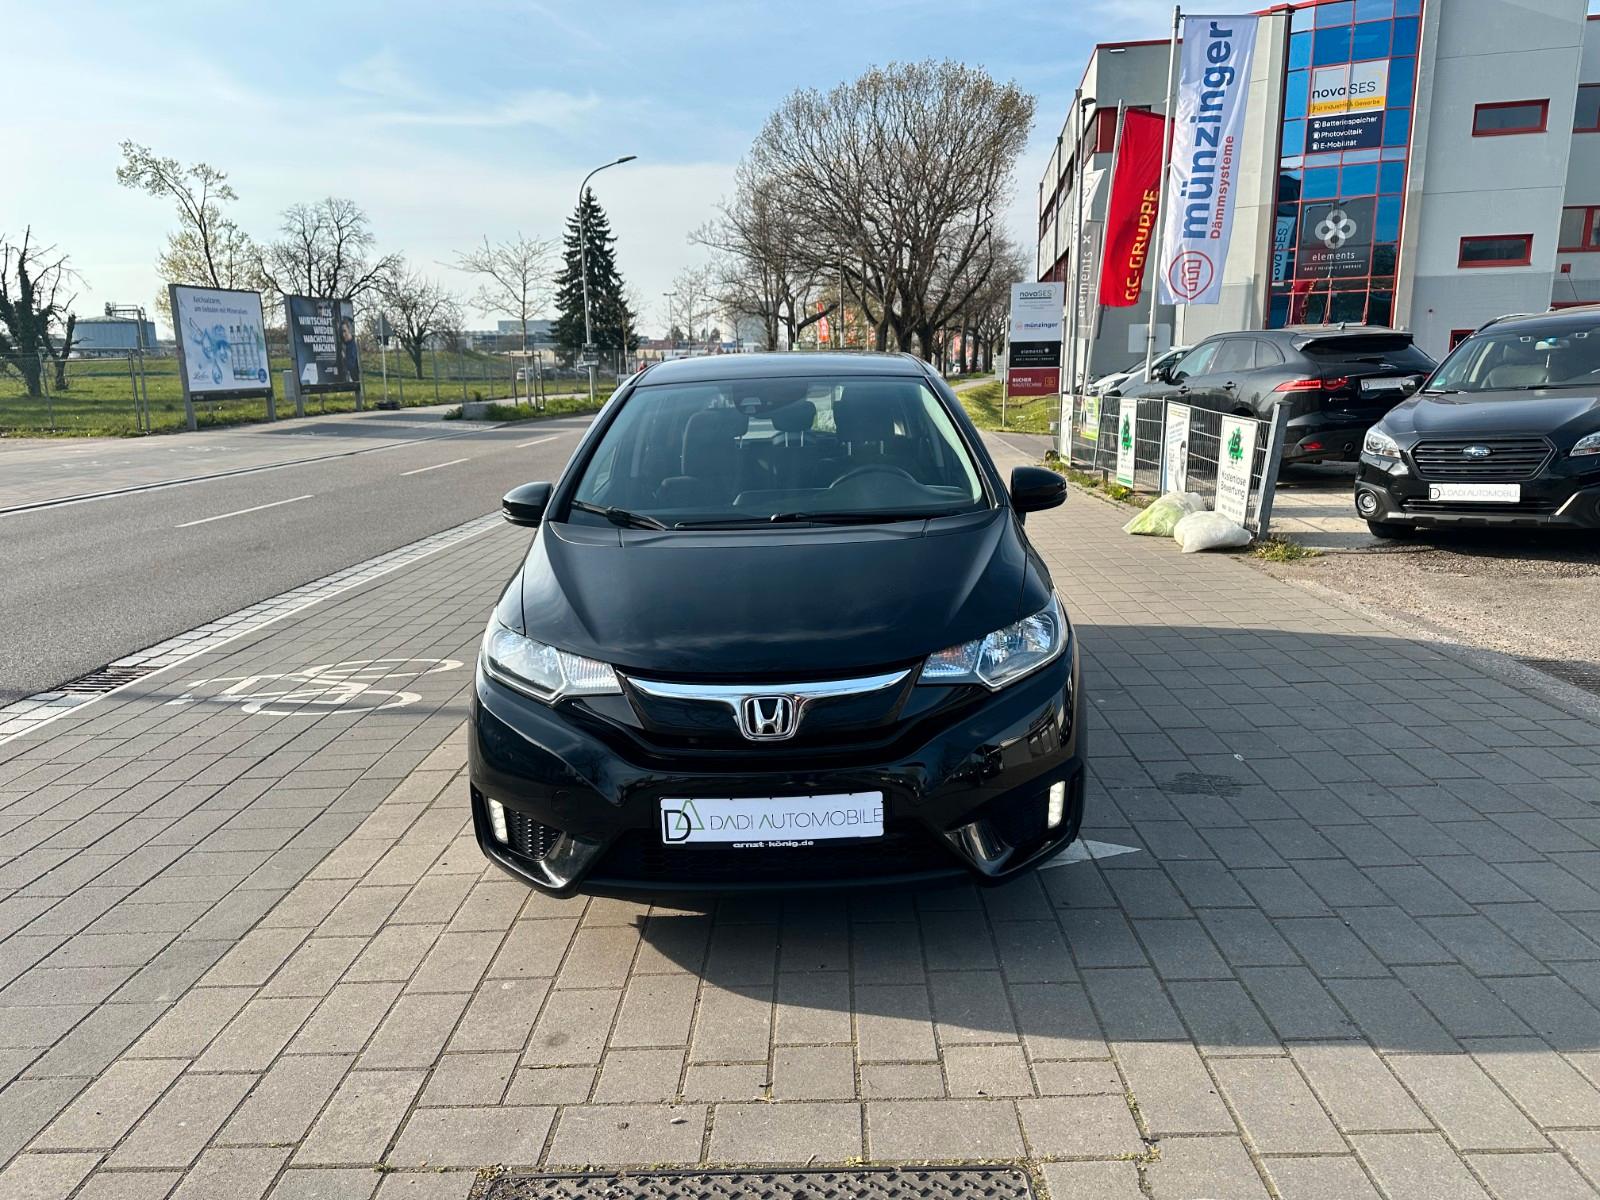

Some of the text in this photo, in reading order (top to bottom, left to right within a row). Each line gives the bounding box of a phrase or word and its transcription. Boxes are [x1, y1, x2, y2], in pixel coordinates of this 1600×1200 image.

[1321, 116, 1378, 128] Batteriespeicher
[1180, 21, 1236, 239] münzinger
[1320, 128, 1363, 138] Photovoltaik
[1210, 135, 1235, 240] Dämmsysteme
[1125, 189, 1159, 301] GC-GRUPPE
[1312, 251, 1356, 261] elements
[298, 316, 333, 326] WIRTSCHAFT
[1024, 321, 1058, 329] münzinger
[313, 326, 334, 335] WIEDER
[303, 335, 335, 344] WACHSTUM
[312, 343, 336, 353] MACHEN
[710, 814, 753, 831] DADI
[758, 807, 884, 830] AUTOMOBILE
